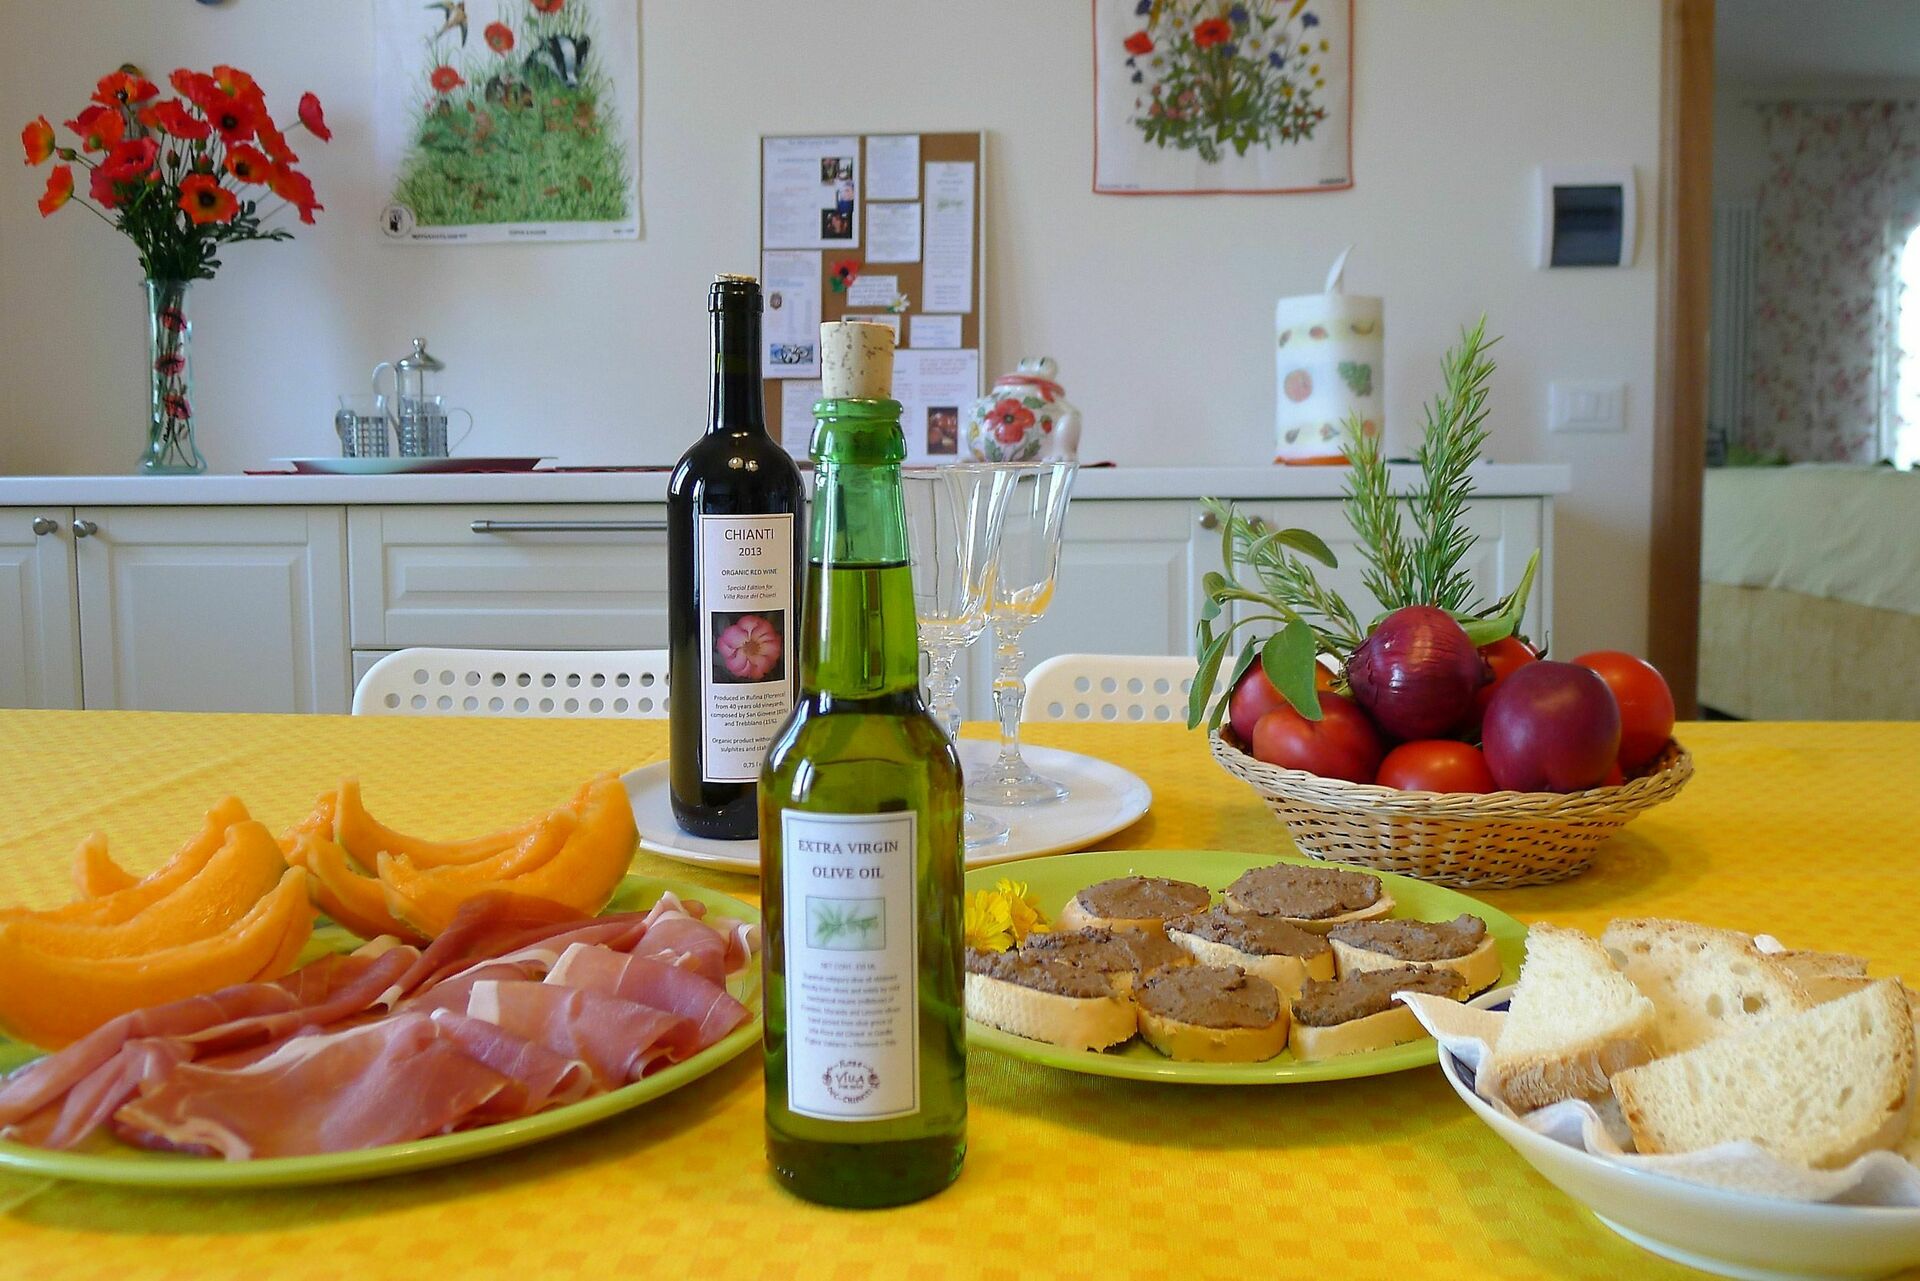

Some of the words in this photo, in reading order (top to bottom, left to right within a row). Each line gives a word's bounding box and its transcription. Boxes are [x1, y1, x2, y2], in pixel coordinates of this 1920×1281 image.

[724, 528, 774, 540] CHIANTI
[739, 548, 762, 556] 2013
[798, 840, 842, 854] EXTRA
[848, 840, 898, 854] VIRGIN
[812, 866, 855, 879] OLIVE
[859, 868, 884, 879] OIL
